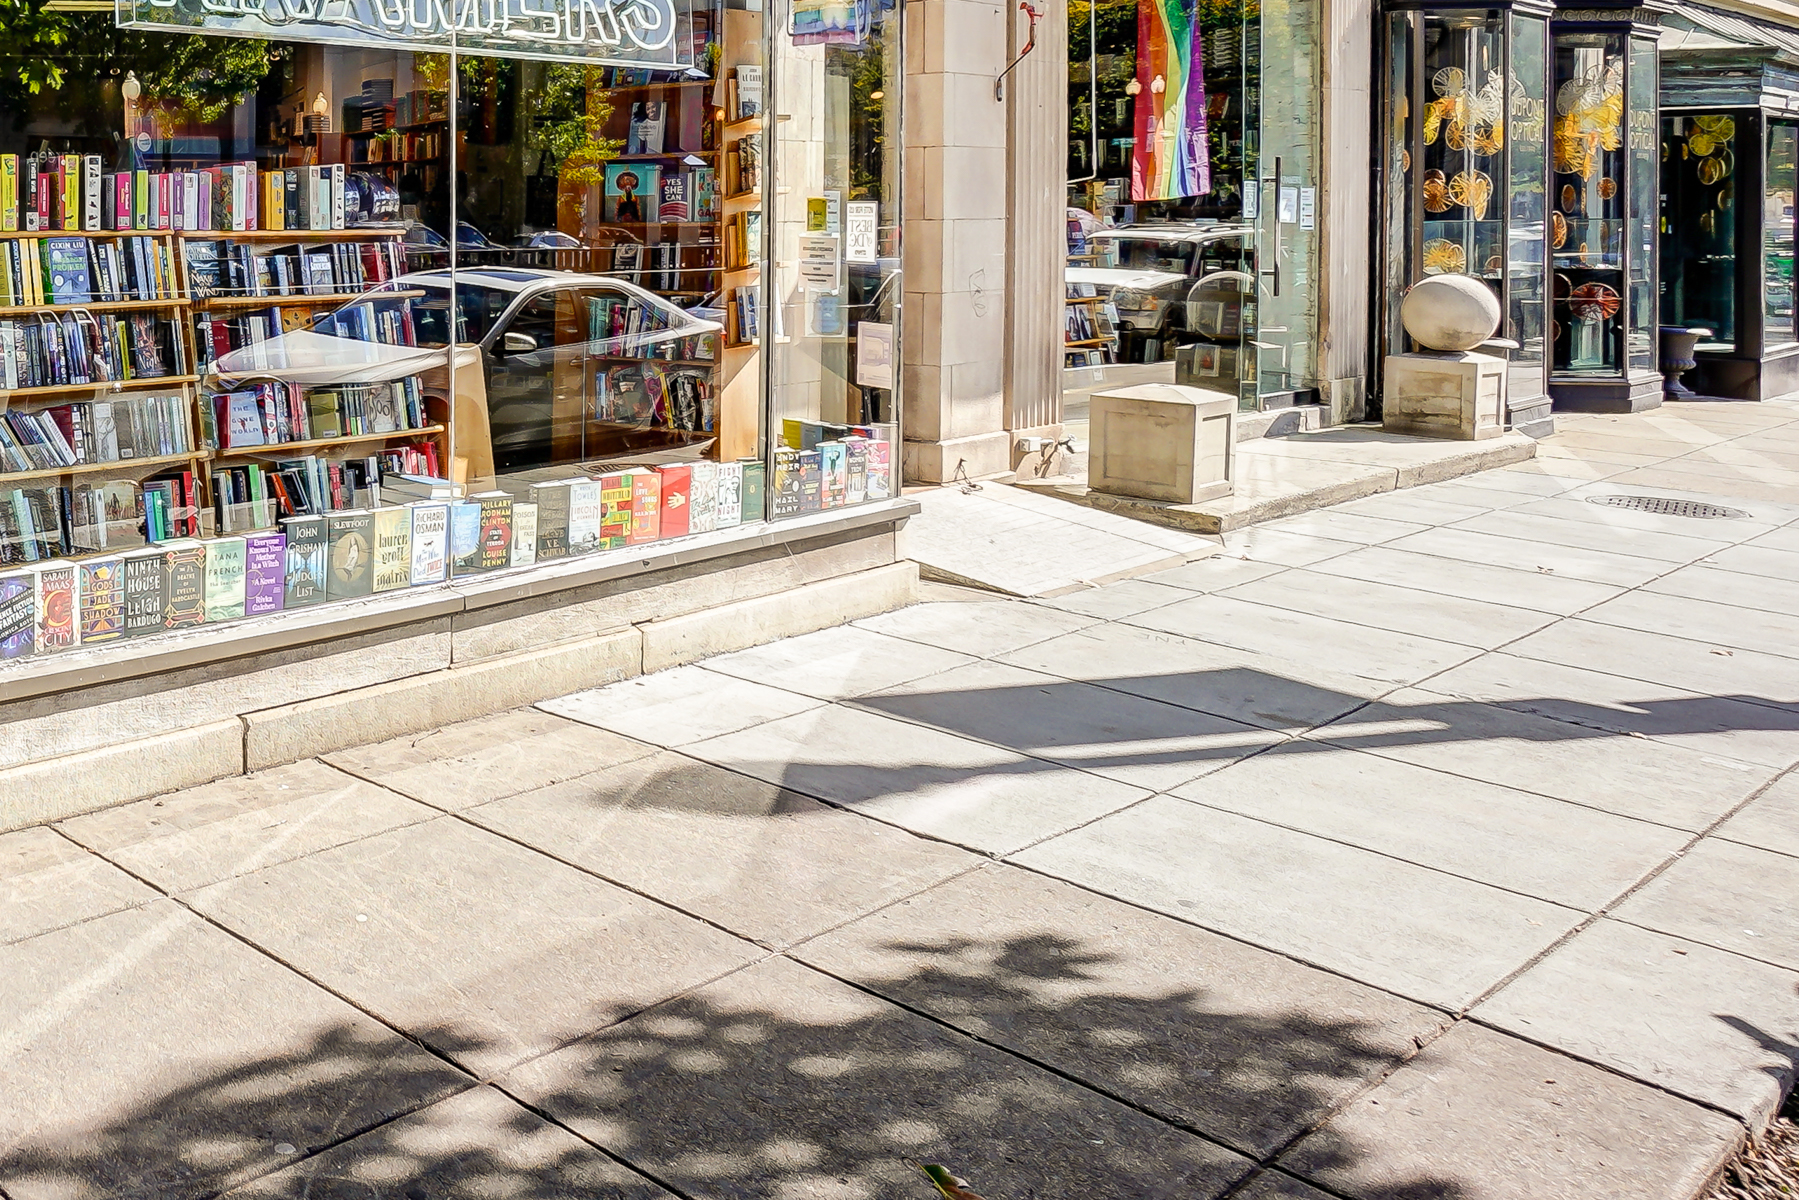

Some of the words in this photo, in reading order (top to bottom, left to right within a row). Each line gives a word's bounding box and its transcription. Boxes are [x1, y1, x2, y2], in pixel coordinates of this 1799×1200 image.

[1511, 120, 1545, 142] OPTICAL
[1630, 131, 1656, 150] OPTICAL
[667, 178, 682, 186] YES
[664, 185, 683, 194] SHE
[50, 241, 71, 250] CIXIN
[72, 241, 85, 249] LIU
[52, 263, 87, 272] PROBLEM
[231, 426, 260, 435] WORLD
[718, 466, 741, 477] FIGHT
[573, 488, 598, 501] TOWLES
[481, 500, 511, 509] HILLARY
[717, 505, 740, 515] NIGHT
[775, 505, 799, 514] MARY
[480, 508, 512, 517] RODHAM
[571, 505, 599, 522] LINCOLN
[333, 519, 370, 530] SLEWFOOT
[481, 517, 511, 527] CLINTON
[296, 526, 318, 540] JOHN
[415, 522, 445, 534] OSMAN
[253, 538, 280, 546] Everyone
[378, 533, 408, 548] lauren
[269, 544, 283, 552] Your
[288, 541, 326, 554] GRISHAM
[214, 552, 239, 562] TANA
[255, 553, 277, 561] Mother
[482, 549, 507, 558] LOUISE
[127, 559, 160, 577] NINTH
[482, 558, 507, 567] PENNY
[208, 565, 243, 576] FRENCH
[43, 571, 68, 583] SARAH
[261, 577, 276, 585] Novel
[46, 580, 71, 591] MAAS
[91, 580, 114, 591] GODS
[127, 575, 160, 593] HOUSE
[296, 586, 315, 598] LIST
[13, 596, 35, 612] FICTION
[93, 594, 112, 605] JADE
[127, 596, 161, 616] LEIGH
[0, 607, 28, 630] FANTASY
[83, 606, 121, 621] SHADOW
[127, 614, 161, 628] BARDUGO
[44, 632, 72, 646] CITY
